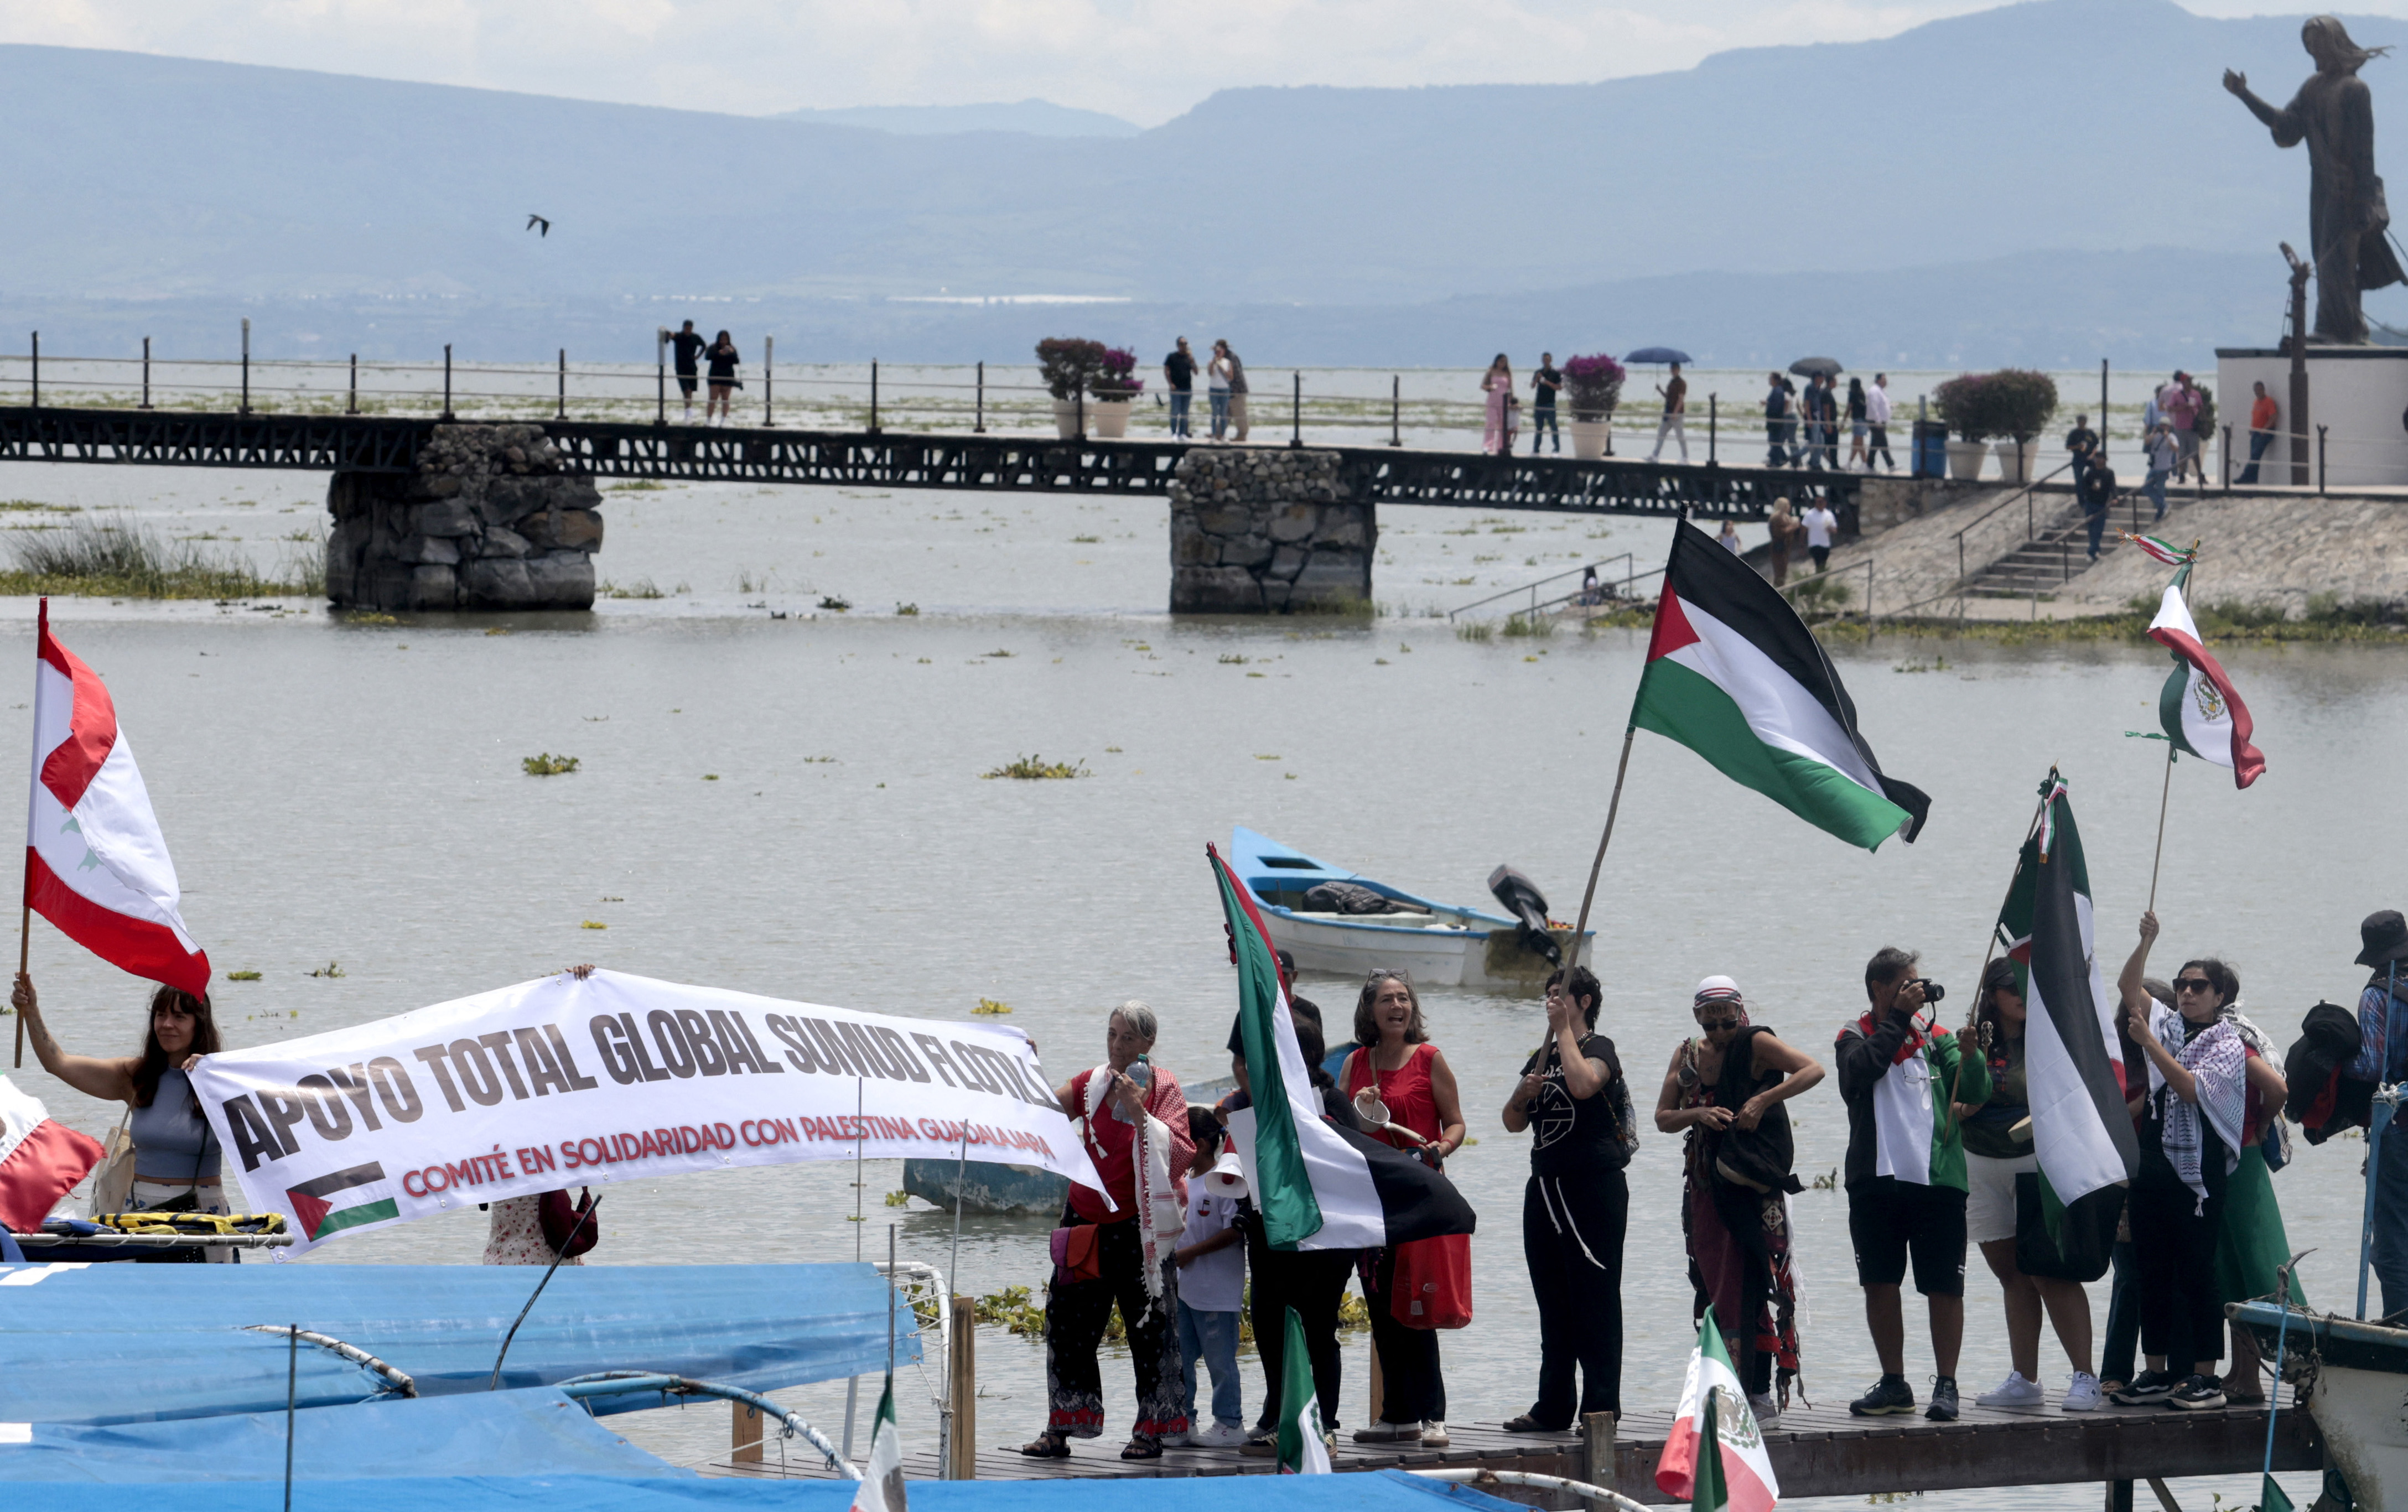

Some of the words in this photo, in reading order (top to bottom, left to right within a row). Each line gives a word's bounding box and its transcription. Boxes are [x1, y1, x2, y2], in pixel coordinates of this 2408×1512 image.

[222, 1056, 423, 1172] APOYO
[413, 1023, 599, 1112] TOTAL
[589, 1009, 785, 1085] GLOBAL
[765, 1013, 931, 1083] SUMUD
[403, 1144, 515, 1198] COMITÉ
[516, 1144, 556, 1175] EN
[560, 1123, 735, 1169] SOLIDARIDAD
[740, 1118, 800, 1147] CON
[799, 1115, 921, 1141] PALESTINA
[918, 1118, 1056, 1160] GUADALAJARA
